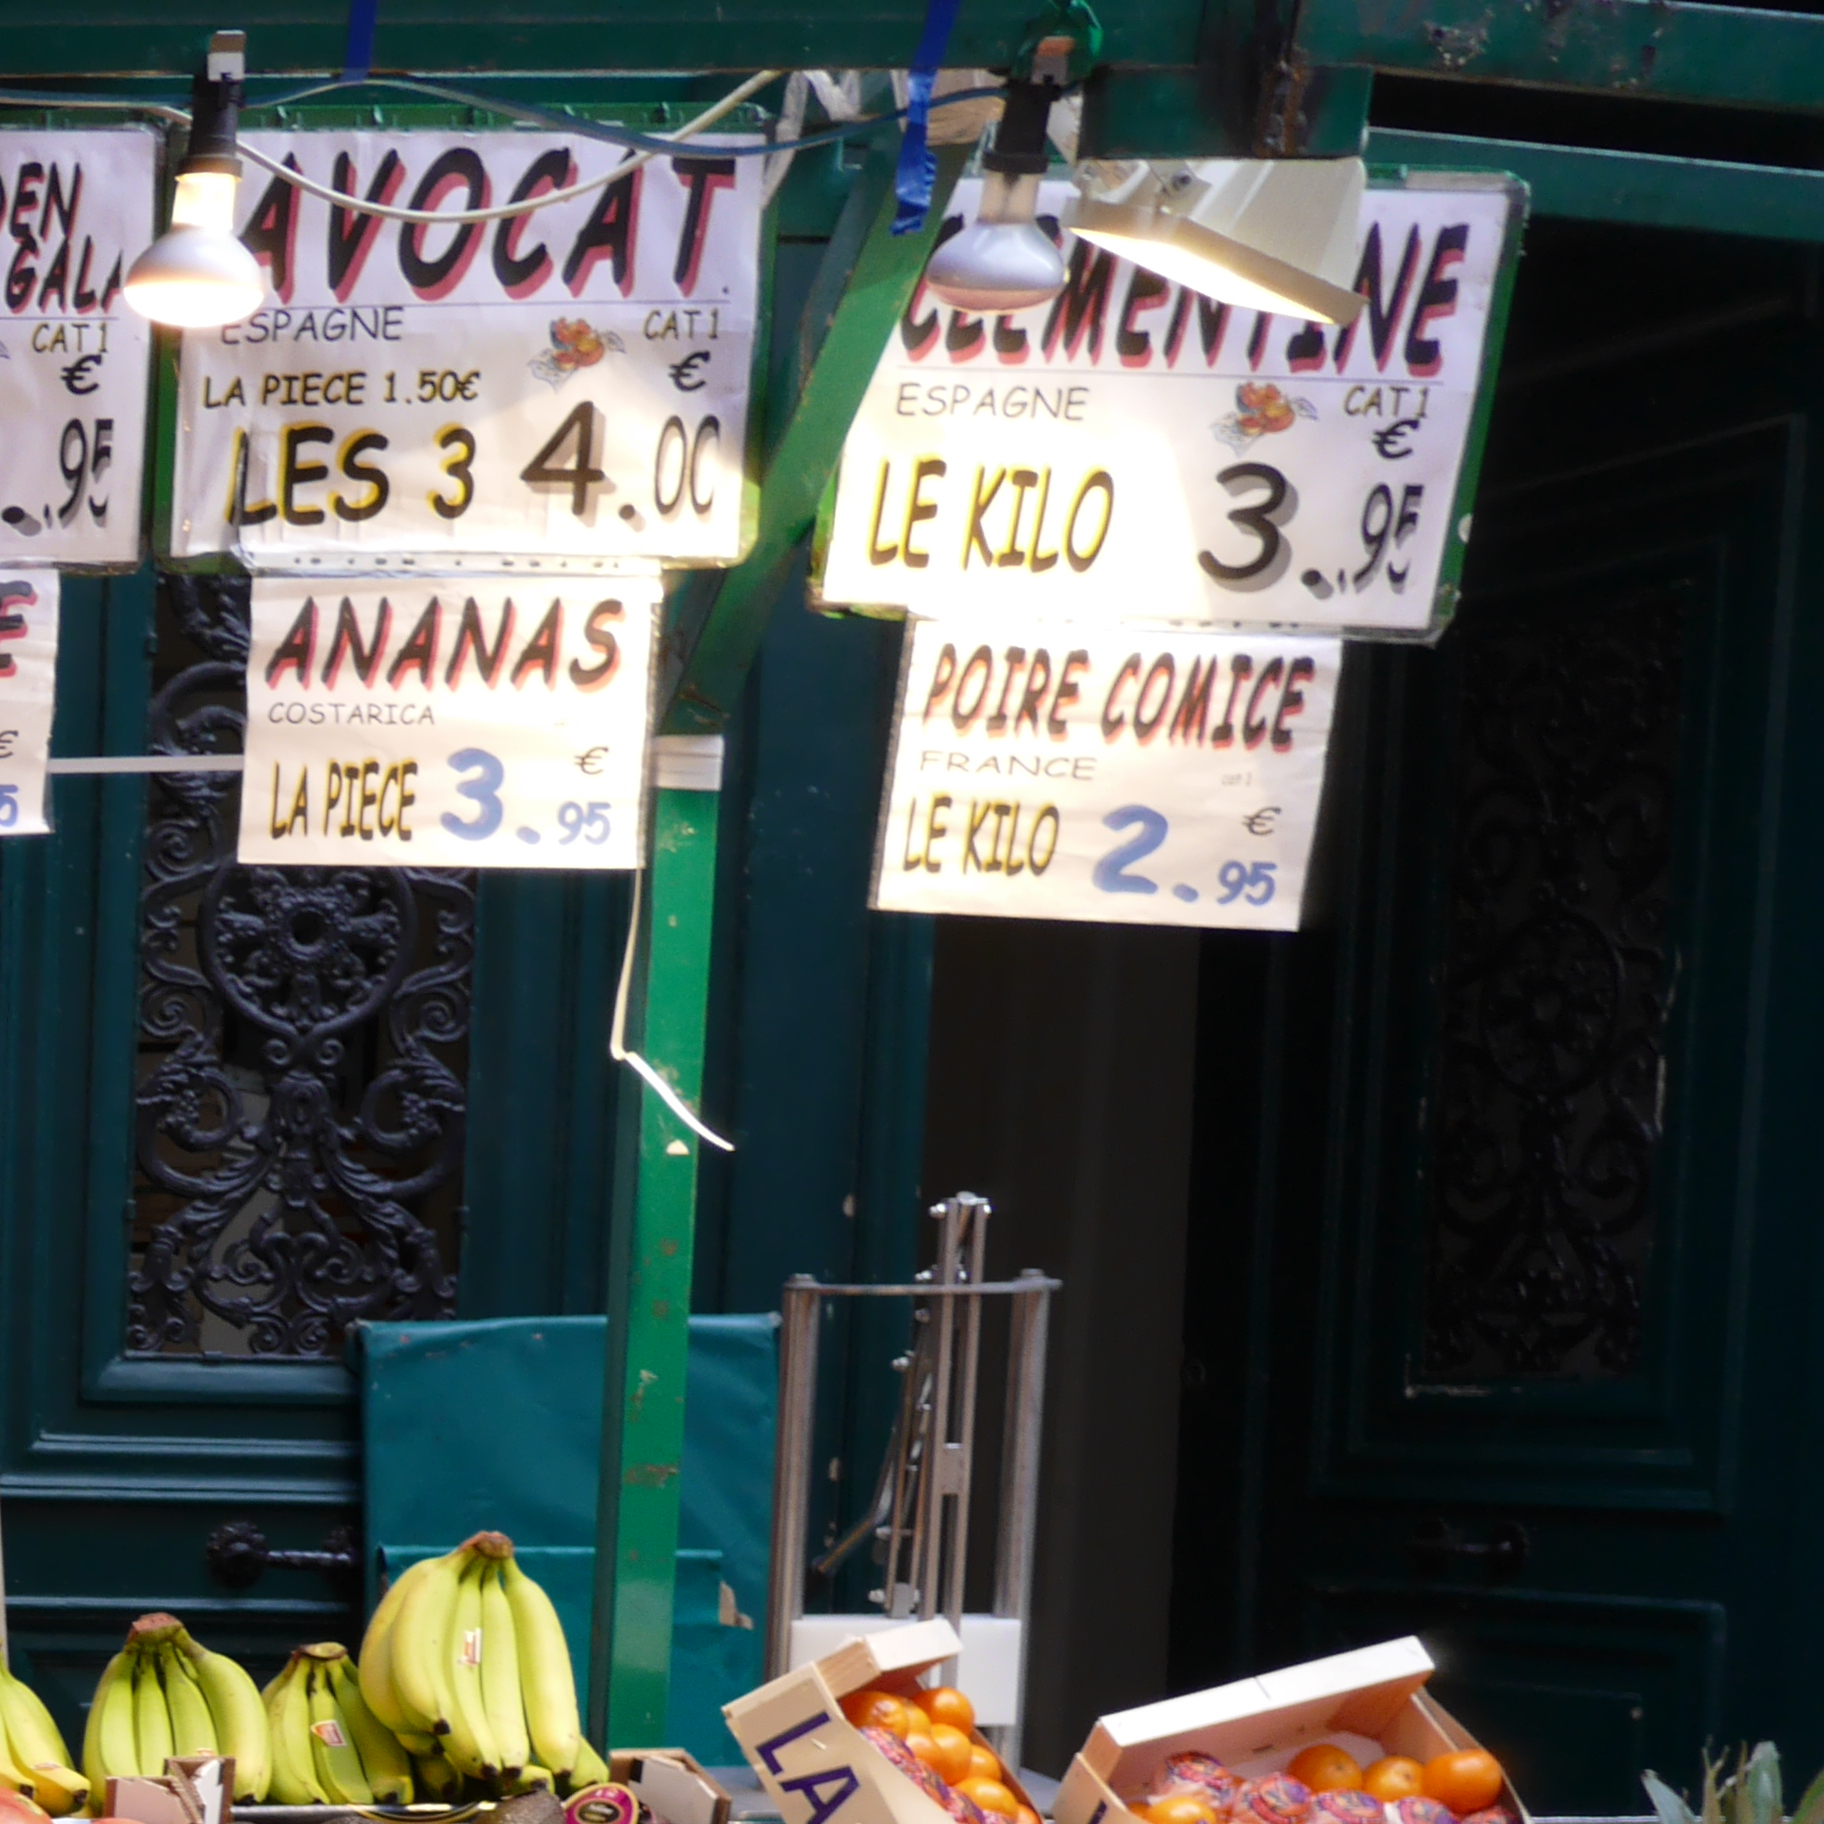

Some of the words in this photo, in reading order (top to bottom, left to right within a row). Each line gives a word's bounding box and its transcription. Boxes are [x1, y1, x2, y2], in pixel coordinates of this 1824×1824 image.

[241, 145, 736, 303] AVOCAT
[4, 234, 123, 313] GALA
[221, 306, 404, 343] ESPAGNE
[203, 375, 245, 409] LA
[262, 371, 366, 406] PIECE
[382, 371, 480, 404] 1.50€
[896, 385, 1090, 422] ESPAGNE
[225, 422, 389, 525] LES
[426, 423, 477, 520] 3
[867, 456, 947, 569] LE
[960, 464, 1115, 573] KILO
[264, 596, 626, 693] ANANAS
[269, 702, 435, 725] COSTARICA
[922, 643, 1090, 741] POIRE
[1100, 651, 1315, 752] COMICE
[270, 761, 308, 841] LA
[323, 757, 417, 842] PIECE
[440, 748, 612, 845] 3.95
[920, 750, 1098, 781] FRANCE
[903, 793, 951, 874] LE
[962, 800, 1060, 877] KILO
[1092, 804, 1277, 906] 2.95
